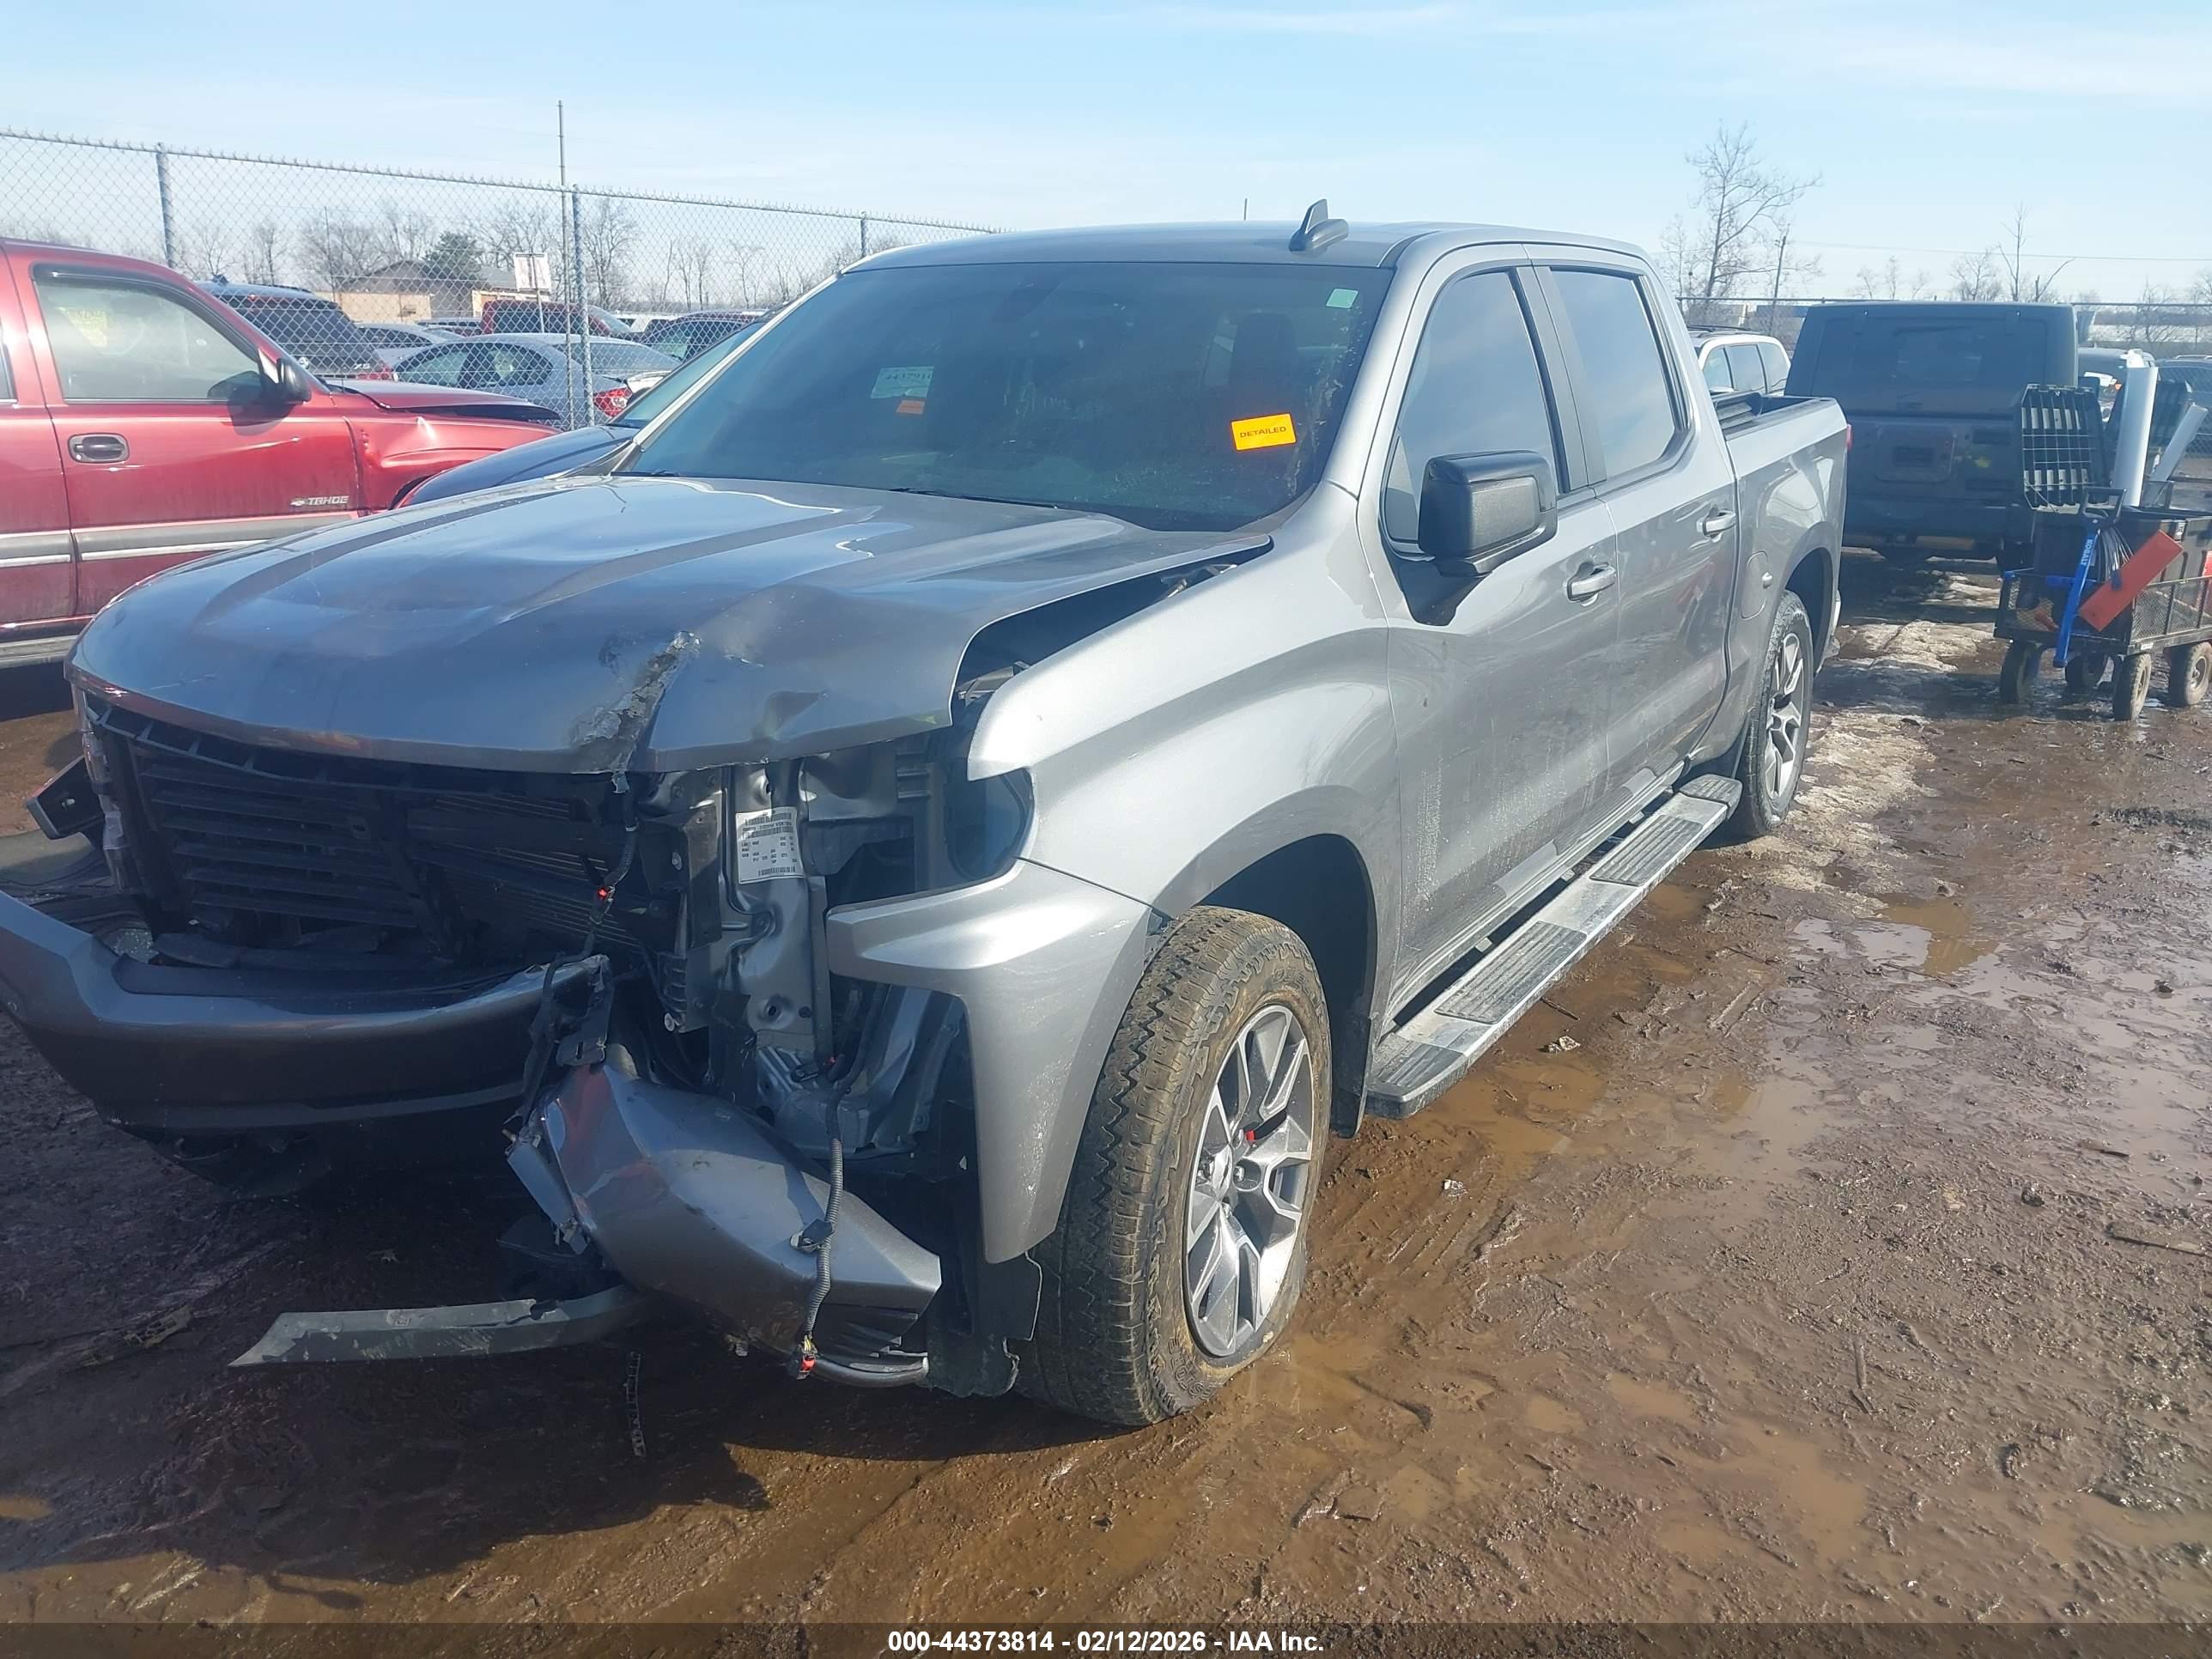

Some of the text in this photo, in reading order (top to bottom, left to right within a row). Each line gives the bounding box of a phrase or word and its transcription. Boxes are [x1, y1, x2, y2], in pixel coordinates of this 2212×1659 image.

[1239, 426, 1287, 439] DETAILED
[307, 495, 350, 506] TAHOE
[2080, 538, 2094, 567] KOBALT
